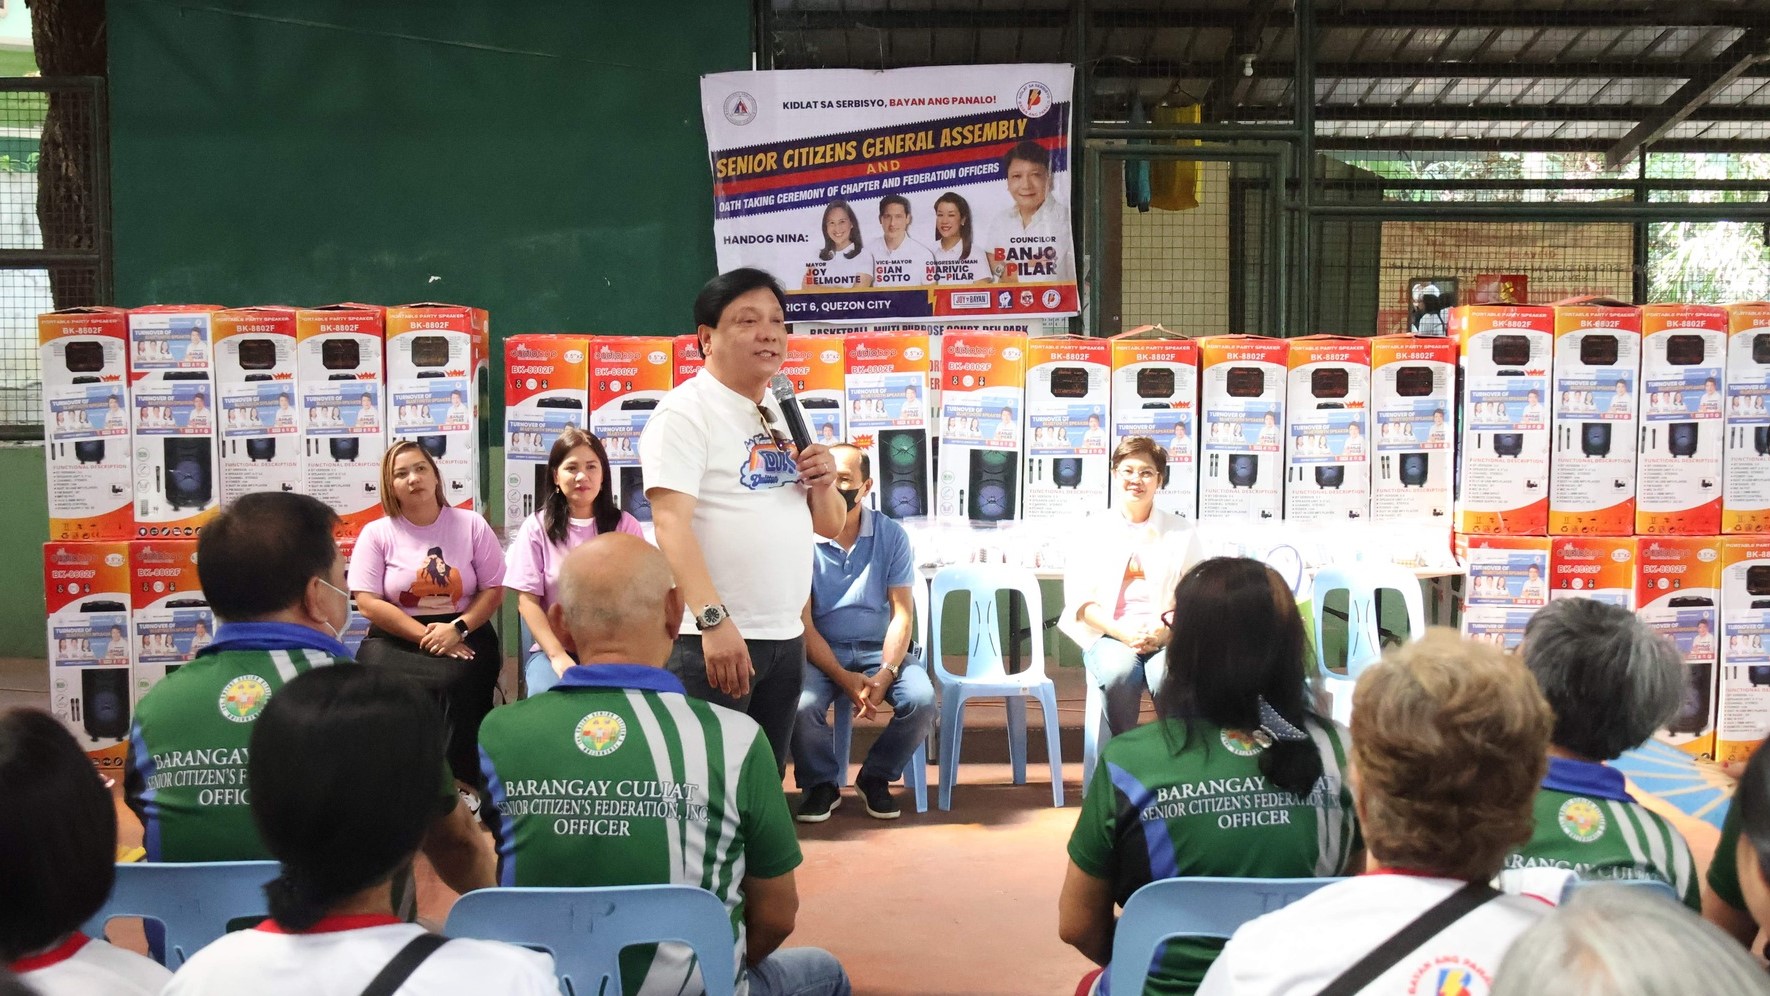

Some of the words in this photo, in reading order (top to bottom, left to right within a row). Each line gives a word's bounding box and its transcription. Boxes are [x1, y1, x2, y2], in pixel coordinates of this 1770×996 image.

[782, 101, 818, 110] KIDLAT
[820, 100, 834, 109] SA
[836, 99, 888, 109] SERBISYO,
[889, 97, 925, 107] BAYAN
[927, 97, 950, 106] ANG
[952, 94, 997, 105] PANALO!
[716, 151, 778, 178] SENIOR
[783, 140, 858, 169] CITIZENS
[862, 129, 935, 159] GENERAL
[940, 118, 1028, 148] ASSEMBLY
[866, 160, 901, 174] AND
[719, 201, 742, 213] OATH
[743, 195, 775, 209] TAKING
[777, 187, 826, 204] CEREMONY
[827, 185, 839, 197] OF
[840, 180, 880, 195] CHAPTER
[882, 177, 900, 190] AND
[902, 169, 956, 186] FEDERATION
[958, 162, 1000, 178] OFFICERS
[723, 234, 774, 245] HANDOG
[776, 233, 809, 244] NINA:
[1010, 236, 1057, 244] COUNCILOR
[994, 246, 1057, 261] BANJO
[806, 268, 827, 277] JOY
[876, 265, 903, 274] GIAN
[925, 265, 969, 274] MARIVIC
[1006, 261, 1057, 277] PILAR
[806, 275, 861, 285] BELMONTE
[876, 274, 911, 283] SOTTO
[926, 272, 974, 282] CO-PILAR
[809, 302, 820, 313] 6,
[821, 300, 865, 311] QUEZON
[866, 299, 892, 310] CITY
[320, 324, 359, 332] BK-8802F
[410, 321, 449, 329] BK-8802F
[1492, 320, 1532, 329] BK-8802F
[1580, 320, 1620, 328] BK-8802F
[1666, 320, 1706, 328] BK-8802F
[1050, 353, 1090, 361] BK-8802F
[1136, 353, 1176, 361] BK-8802F
[1226, 352, 1266, 361] BK-8802F
[1310, 353, 1350, 361] BK-8802F
[1395, 352, 1435, 360] BK-8802F
[511, 365, 554, 374] BK-8802F
[594, 367, 638, 376] BK-8802F
[1643, 564, 1687, 574] BK-8802F
[174, 768, 236, 787] CITIZEN'S
[505, 779, 612, 798] BARANGAY
[616, 780, 699, 800] CULIAT
[1157, 776, 1266, 803] BARANGAY
[497, 800, 529, 816] SENIOR
[530, 798, 591, 816] CITIZEN'S
[1141, 802, 1186, 821] SENIOR
[1188, 794, 1251, 816] CITIZEN'S
[1217, 809, 1291, 829] OFFICER
[553, 818, 631, 837] OFFICER
